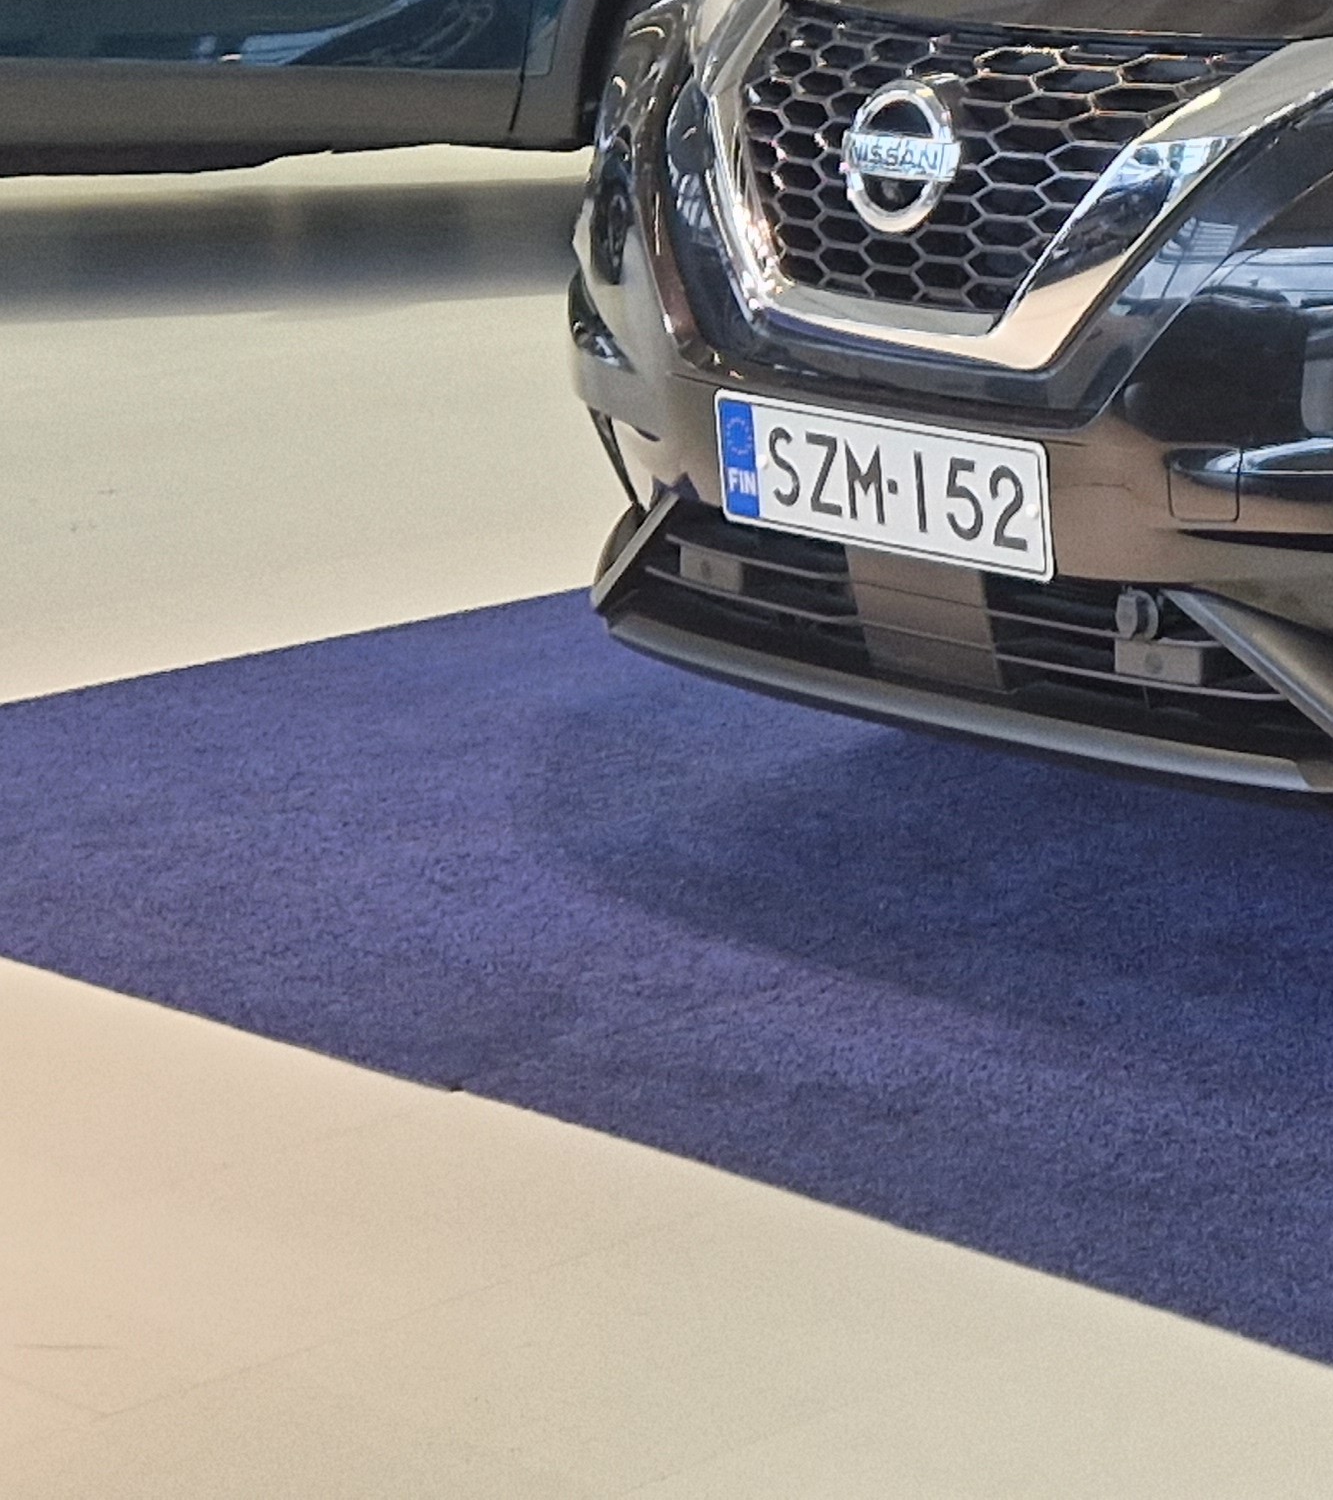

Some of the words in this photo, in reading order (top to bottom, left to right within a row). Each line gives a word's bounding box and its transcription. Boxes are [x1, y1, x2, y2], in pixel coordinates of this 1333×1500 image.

[853, 144, 939, 173] NISSAN
[726, 466, 757, 496] FIN
[767, 426, 1029, 552] SZM-152
